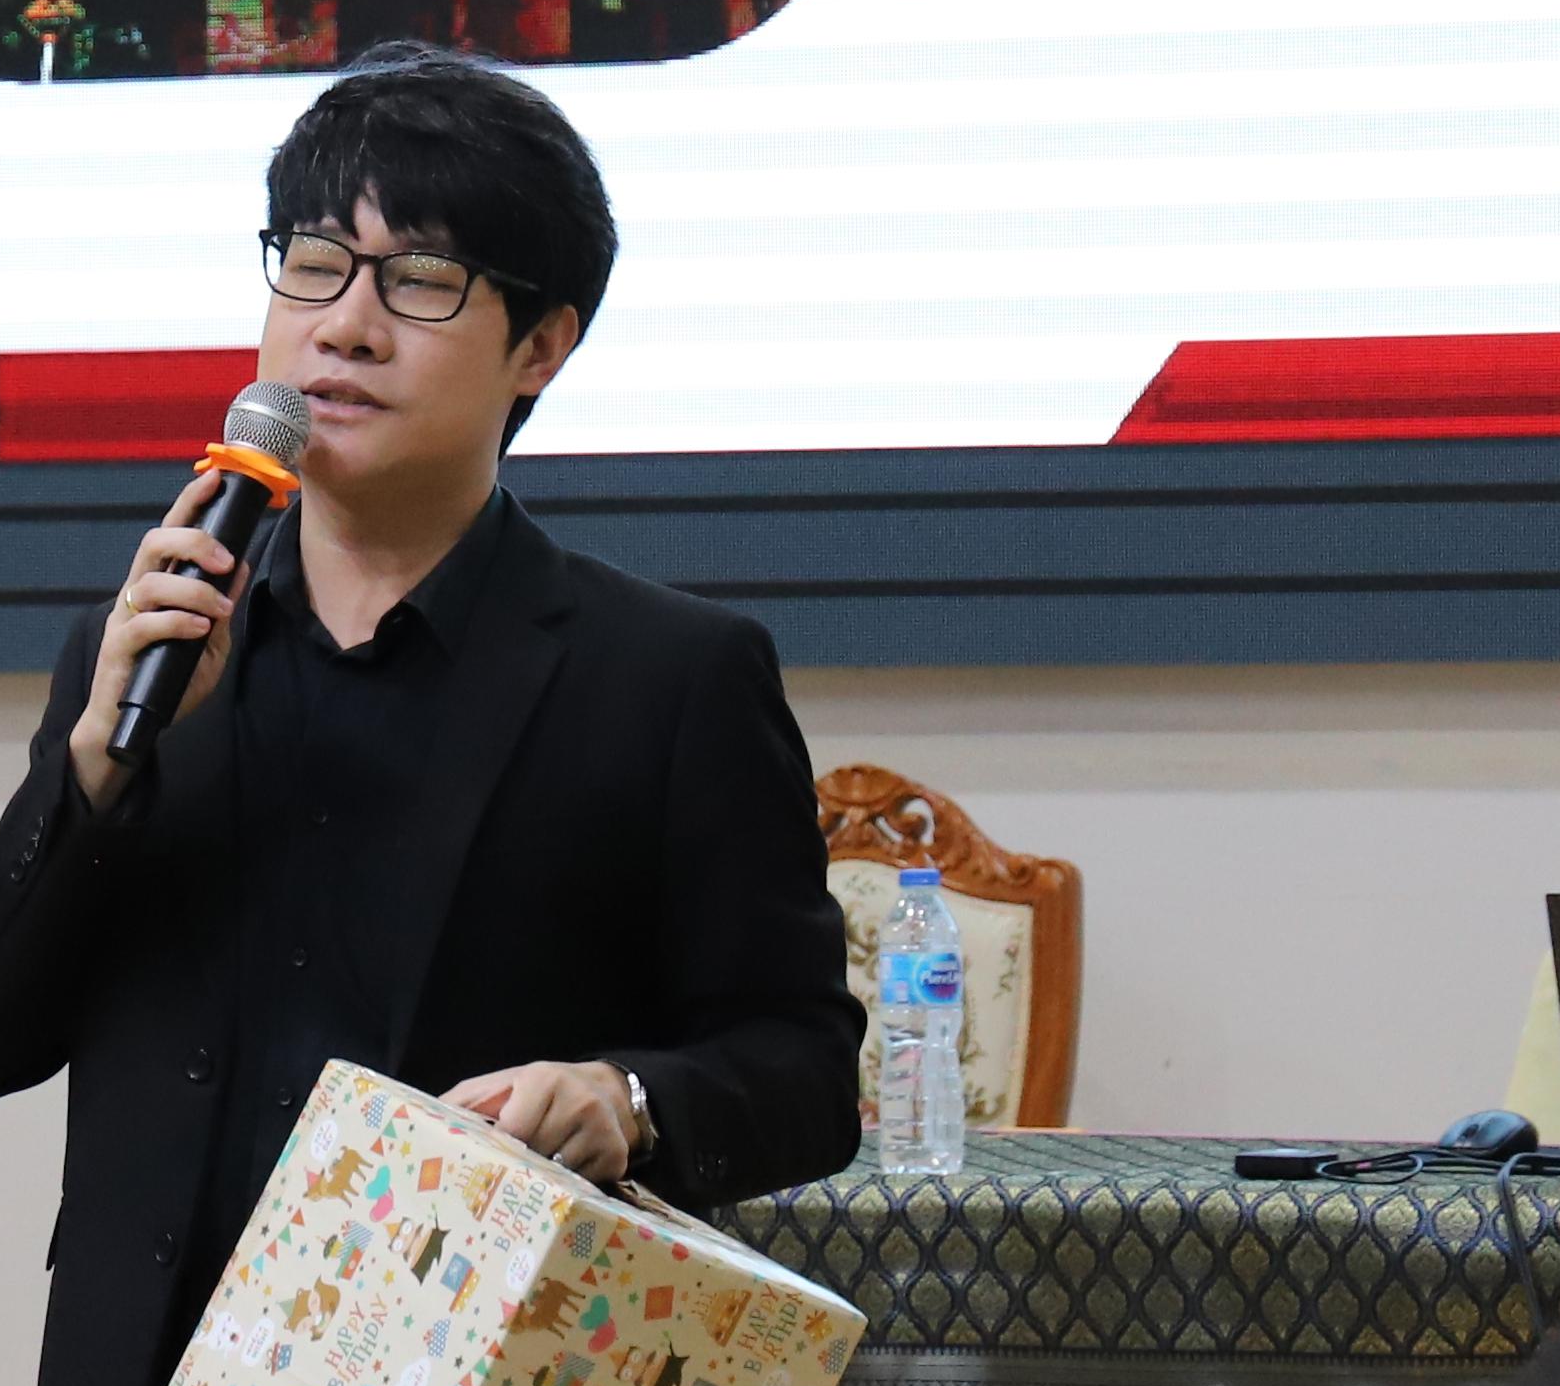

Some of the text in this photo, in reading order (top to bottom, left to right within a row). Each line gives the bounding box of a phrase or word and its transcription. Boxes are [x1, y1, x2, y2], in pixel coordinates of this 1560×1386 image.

[494, 1180, 548, 1253] BIRTHD
[325, 1300, 367, 1369] HAPPY
[737, 1283, 779, 1351] HAPPY
[743, 1290, 804, 1375] BIRTHDA
